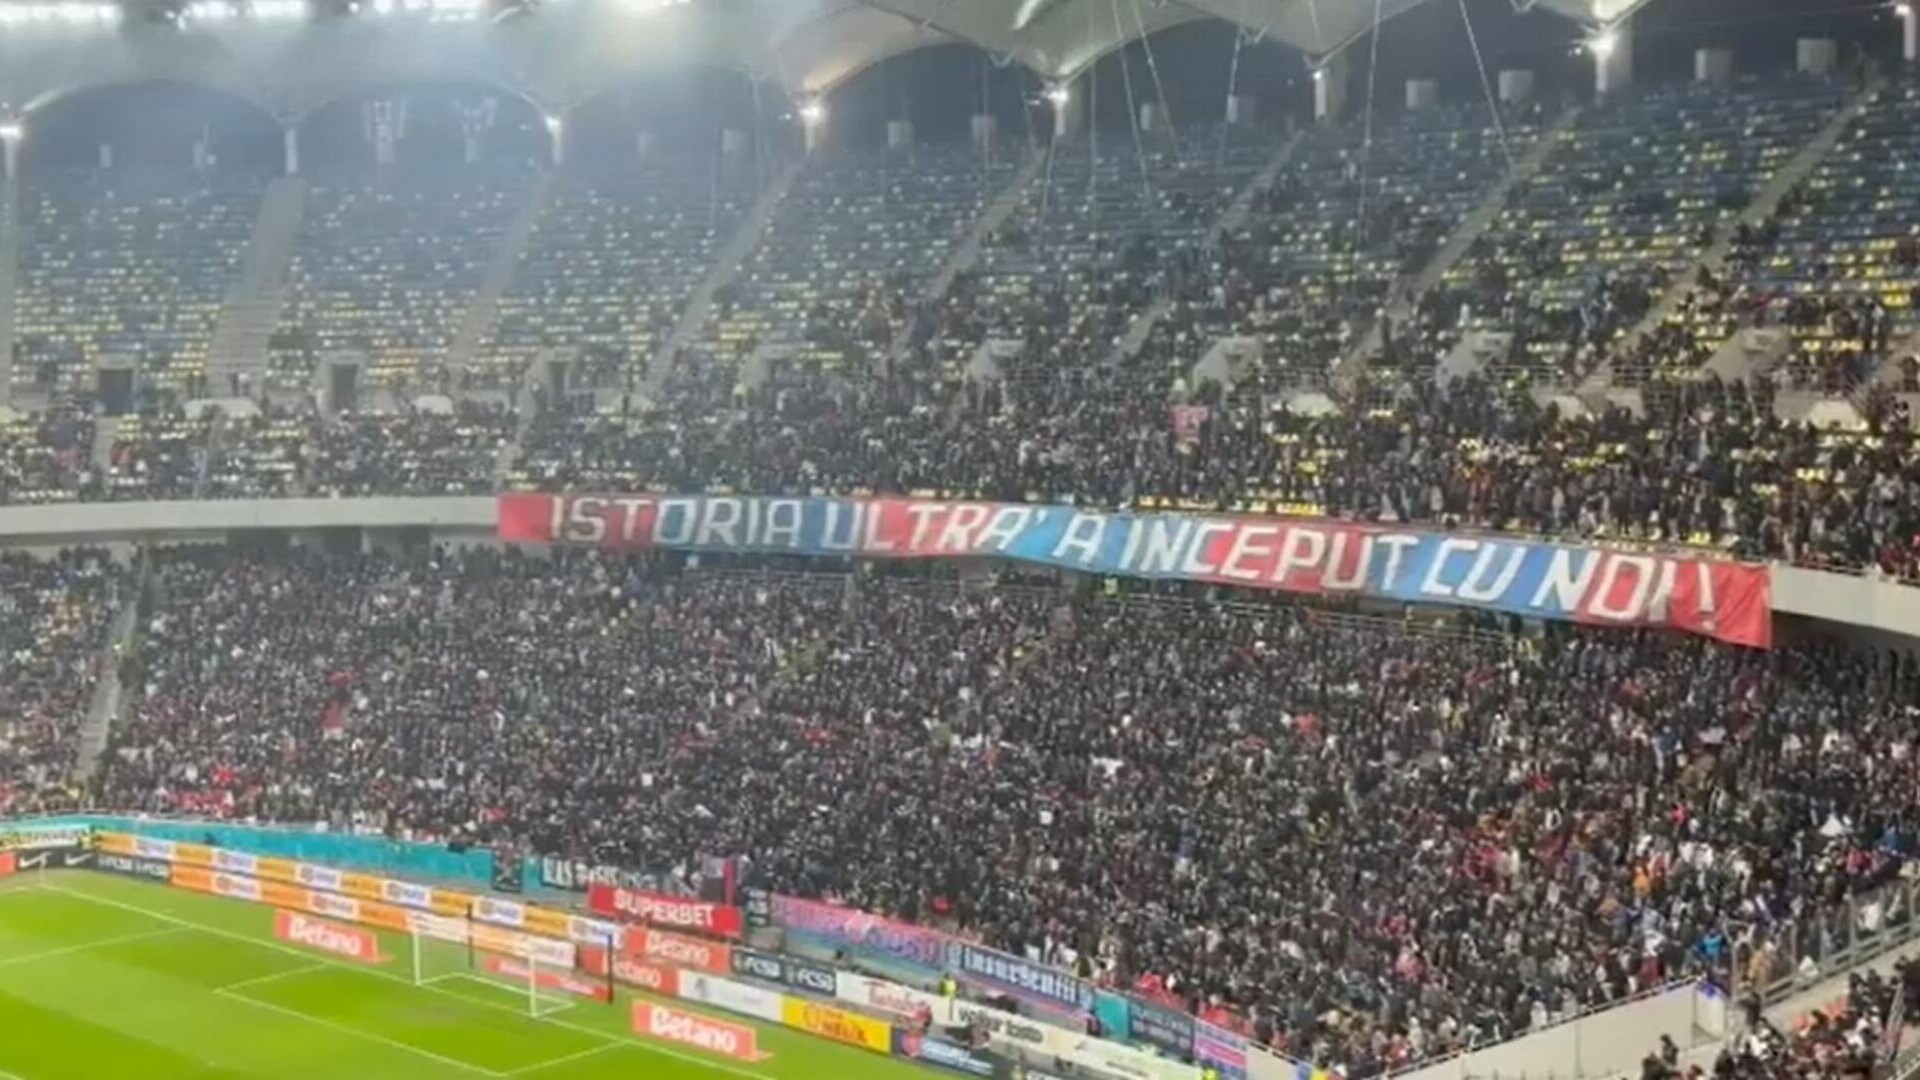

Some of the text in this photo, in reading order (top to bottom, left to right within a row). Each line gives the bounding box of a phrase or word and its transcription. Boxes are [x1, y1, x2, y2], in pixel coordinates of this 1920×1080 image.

[550, 496, 801, 548] ISTORIA
[1053, 513, 1108, 561] A
[1121, 519, 1419, 592] INCEPUT
[1421, 539, 1521, 601] CU
[612, 887, 715, 927] SUPERBET
[288, 915, 361, 954] Betano
[645, 930, 710, 965] Betano
[743, 955, 781, 979] FCSB
[796, 967, 836, 993] FCSB
[649, 1004, 737, 1054] Betano
